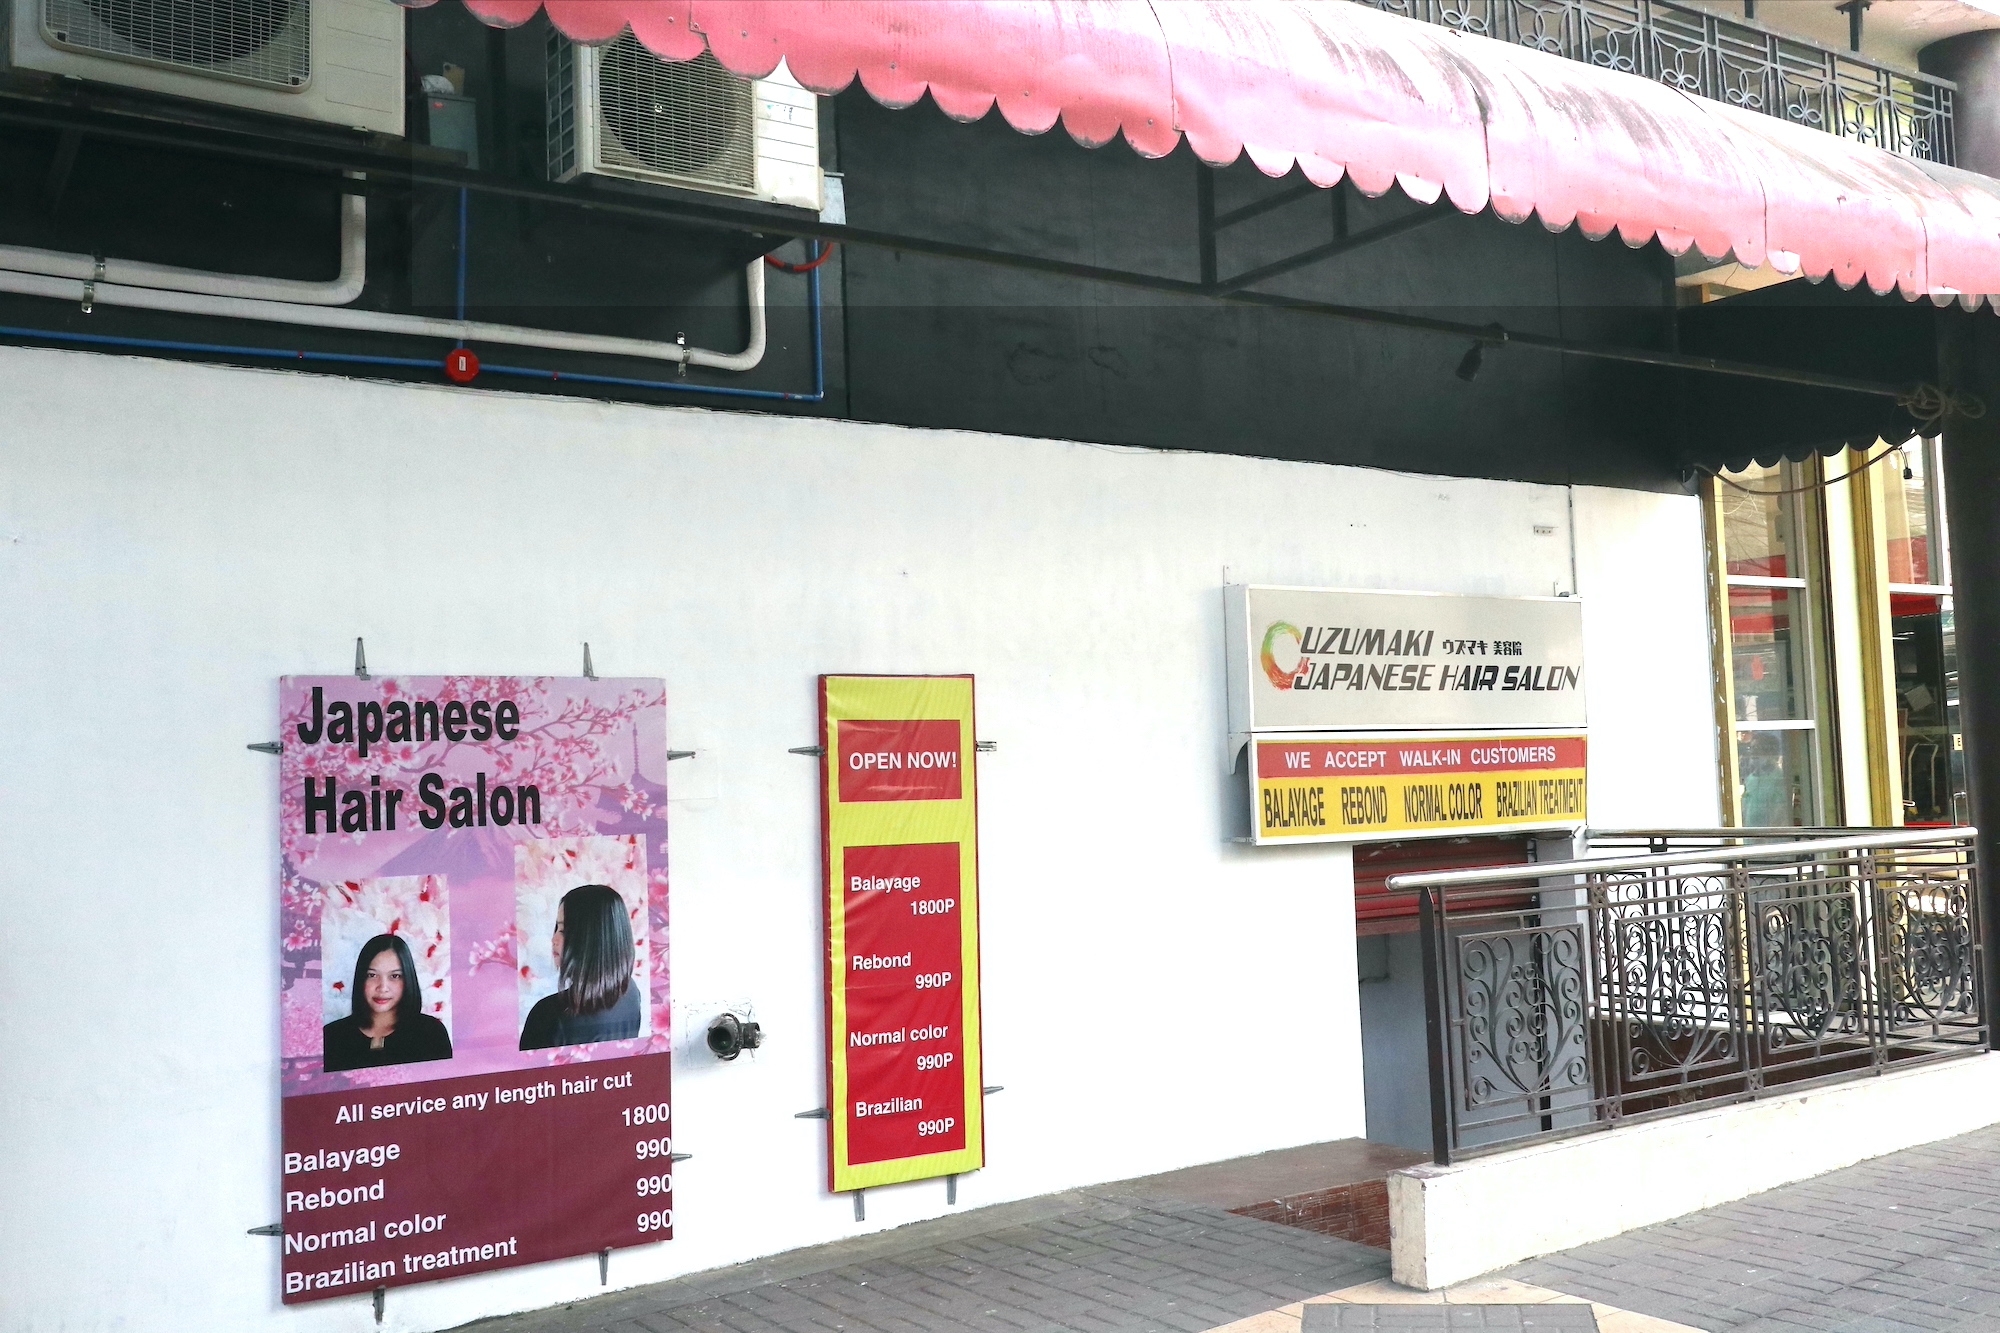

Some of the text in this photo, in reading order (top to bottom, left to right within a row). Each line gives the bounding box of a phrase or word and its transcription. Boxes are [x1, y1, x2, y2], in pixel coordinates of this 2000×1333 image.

[1300, 626, 1435, 657] UZUMAKI
[1493, 641, 1522, 655] 美容院
[1294, 662, 1580, 691] JAPANESE HAIR SALON
[297, 687, 520, 758] Japanese
[849, 752, 957, 769] OPEN NOW!
[1285, 746, 1556, 769] WE ACCEPT WALK-IN CUSTOMERS
[304, 772, 541, 834] Hair Salon
[1264, 778, 1583, 828] BALAYAGE REBOND NORMAL COLOR BRAZILIAN TREATMENT
[850, 876, 921, 894] Balayage
[910, 898, 955, 915] 1800P
[852, 952, 912, 970] Rebond
[915, 971, 952, 989] 990P
[850, 1025, 949, 1047] Normal color
[917, 1052, 954, 1070] 990P
[335, 1071, 633, 1124] All service any length hair cut
[855, 1097, 923, 1118] Brazilian
[621, 1102, 670, 1126] 1800
[918, 1117, 955, 1136] 990P
[284, 1143, 401, 1175] Balayage
[635, 1137, 672, 1160] 990
[286, 1179, 385, 1213] Rebond
[636, 1174, 672, 1197] 990
[637, 1209, 672, 1233] 990
[284, 1214, 447, 1255] Normal color
[286, 1236, 517, 1294] Brazilian treatment
